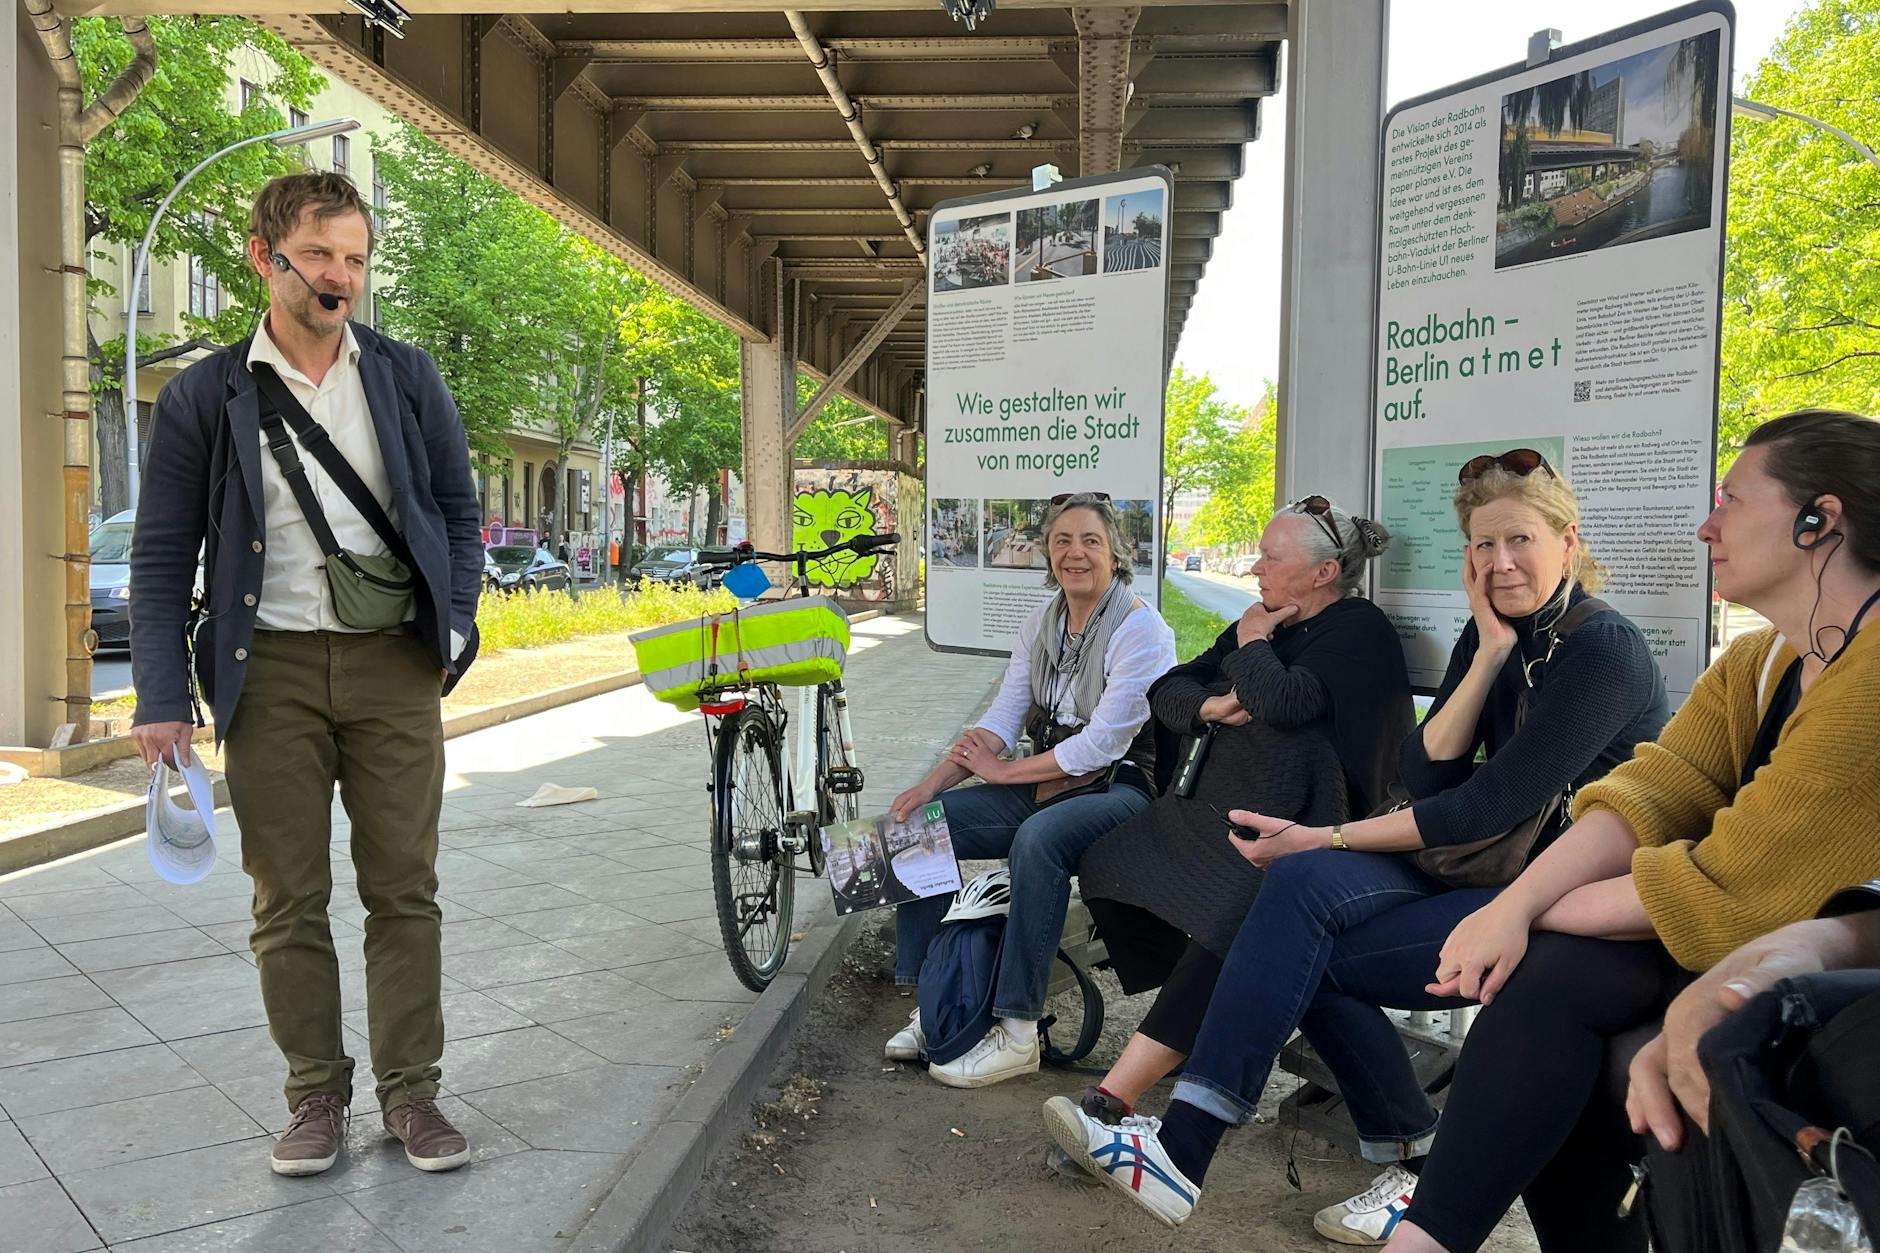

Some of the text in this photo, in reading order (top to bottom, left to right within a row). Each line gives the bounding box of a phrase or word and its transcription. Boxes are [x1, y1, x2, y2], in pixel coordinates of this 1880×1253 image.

[1392, 106, 1485, 139] Die Vision der Radbahn
[1392, 120, 1486, 153] entwickelte sich 2014 als
[1390, 153, 1473, 180] meinnützigen Vereins
[1391, 139, 1475, 167] erstes Projekt des ge-
[1390, 167, 1472, 196] paper planes e.V. Die
[1390, 178, 1484, 208] Idee war und ist es, dem
[1389, 194, 1485, 221] weitgehend vergessenen
[1389, 209, 1476, 235] Raum unter dem denk-
[1388, 224, 1475, 249] malgeschützten Hoch-
[1388, 235, 1489, 263] bahn-Viadukt der Berliner
[1387, 254, 1474, 276] U-Bahn-Linie U1 neues
[1387, 269, 1468, 290] Leben einzuhauchen.
[1387, 308, 1495, 350] Radbahn
[1386, 351, 1448, 386] Berlin
[957, 386, 1126, 421] Wie gestalten wir
[1384, 388, 1426, 422] auf.
[944, 413, 1140, 443] zusammen die Stadt
[1632, 429, 1662, 438] Radbahn?
[976, 444, 1100, 477] von morgen?
